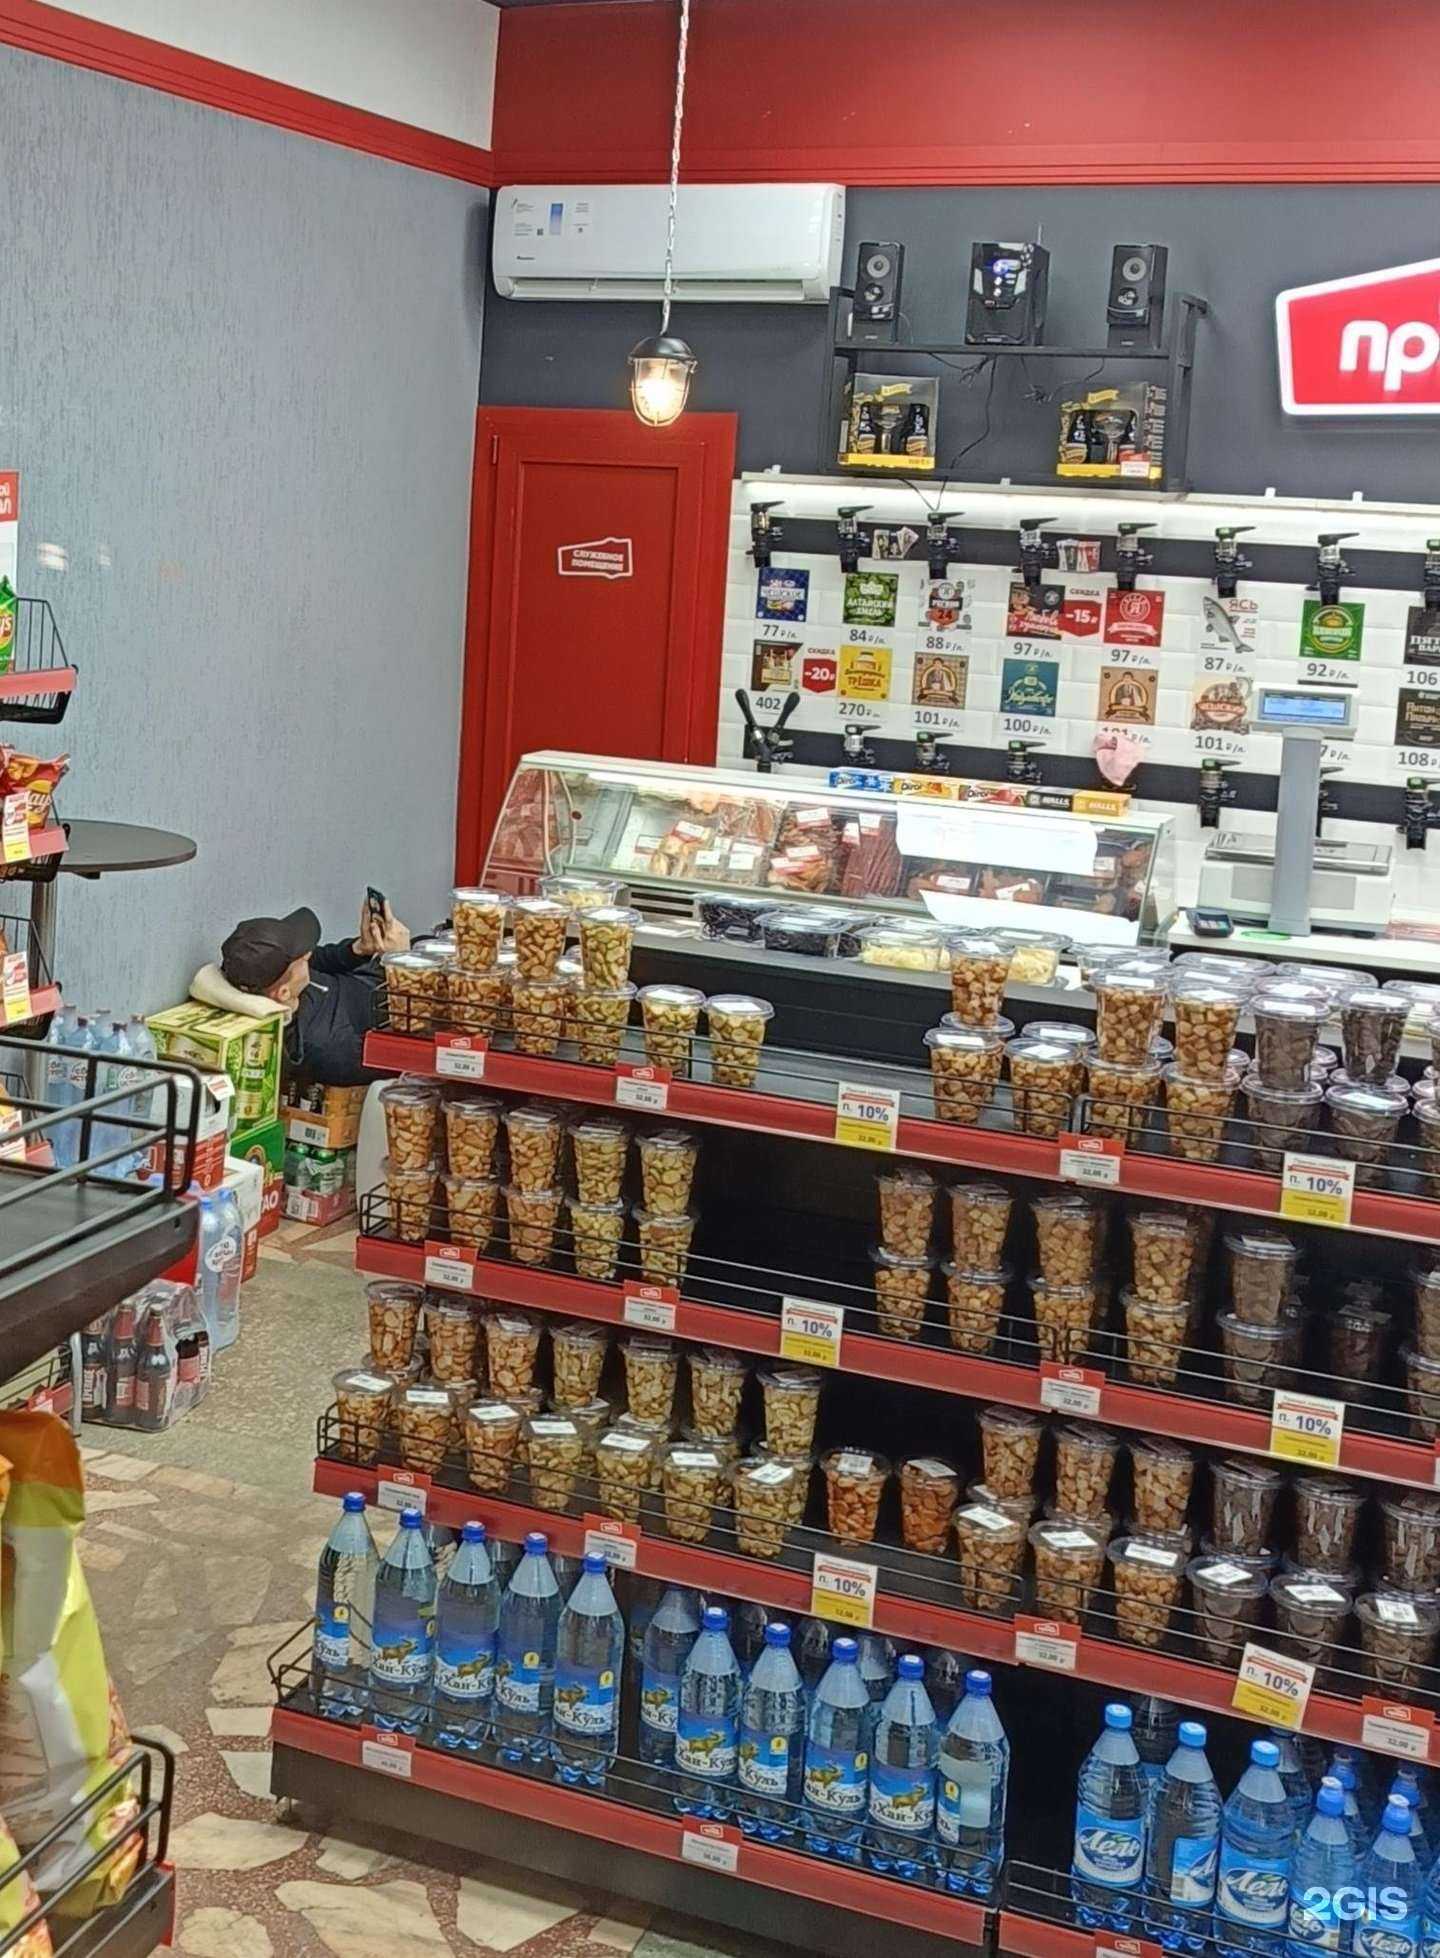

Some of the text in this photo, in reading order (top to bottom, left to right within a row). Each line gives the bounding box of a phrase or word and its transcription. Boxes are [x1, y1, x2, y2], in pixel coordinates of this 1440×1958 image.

[762, 624, 779, 637] 77
[850, 629, 867, 643] 84
[926, 636, 944, 650] 88
[1014, 642, 1032, 656] 97
[1111, 649, 1130, 663] 97
[1204, 657, 1224, 671] 87
[1307, 662, 1327, 677] 92
[1407, 671, 1438, 686] 106
[755, 697, 781, 710] 402
[839, 702, 866, 716] 270
[914, 711, 941, 726] 101
[1002, 718, 1032, 733] 100
[1195, 735, 1223, 750] 101
[1398, 752, 1429, 766] 108
[858, 1104, 889, 1121] 10%
[1306, 1177, 1343, 1194] 10%
[802, 1320, 833, 1338] 10%
[1296, 1415, 1332, 1435] 10%
[834, 1577, 866, 1597] 10%
[1264, 1672, 1299, 1697] 10%
